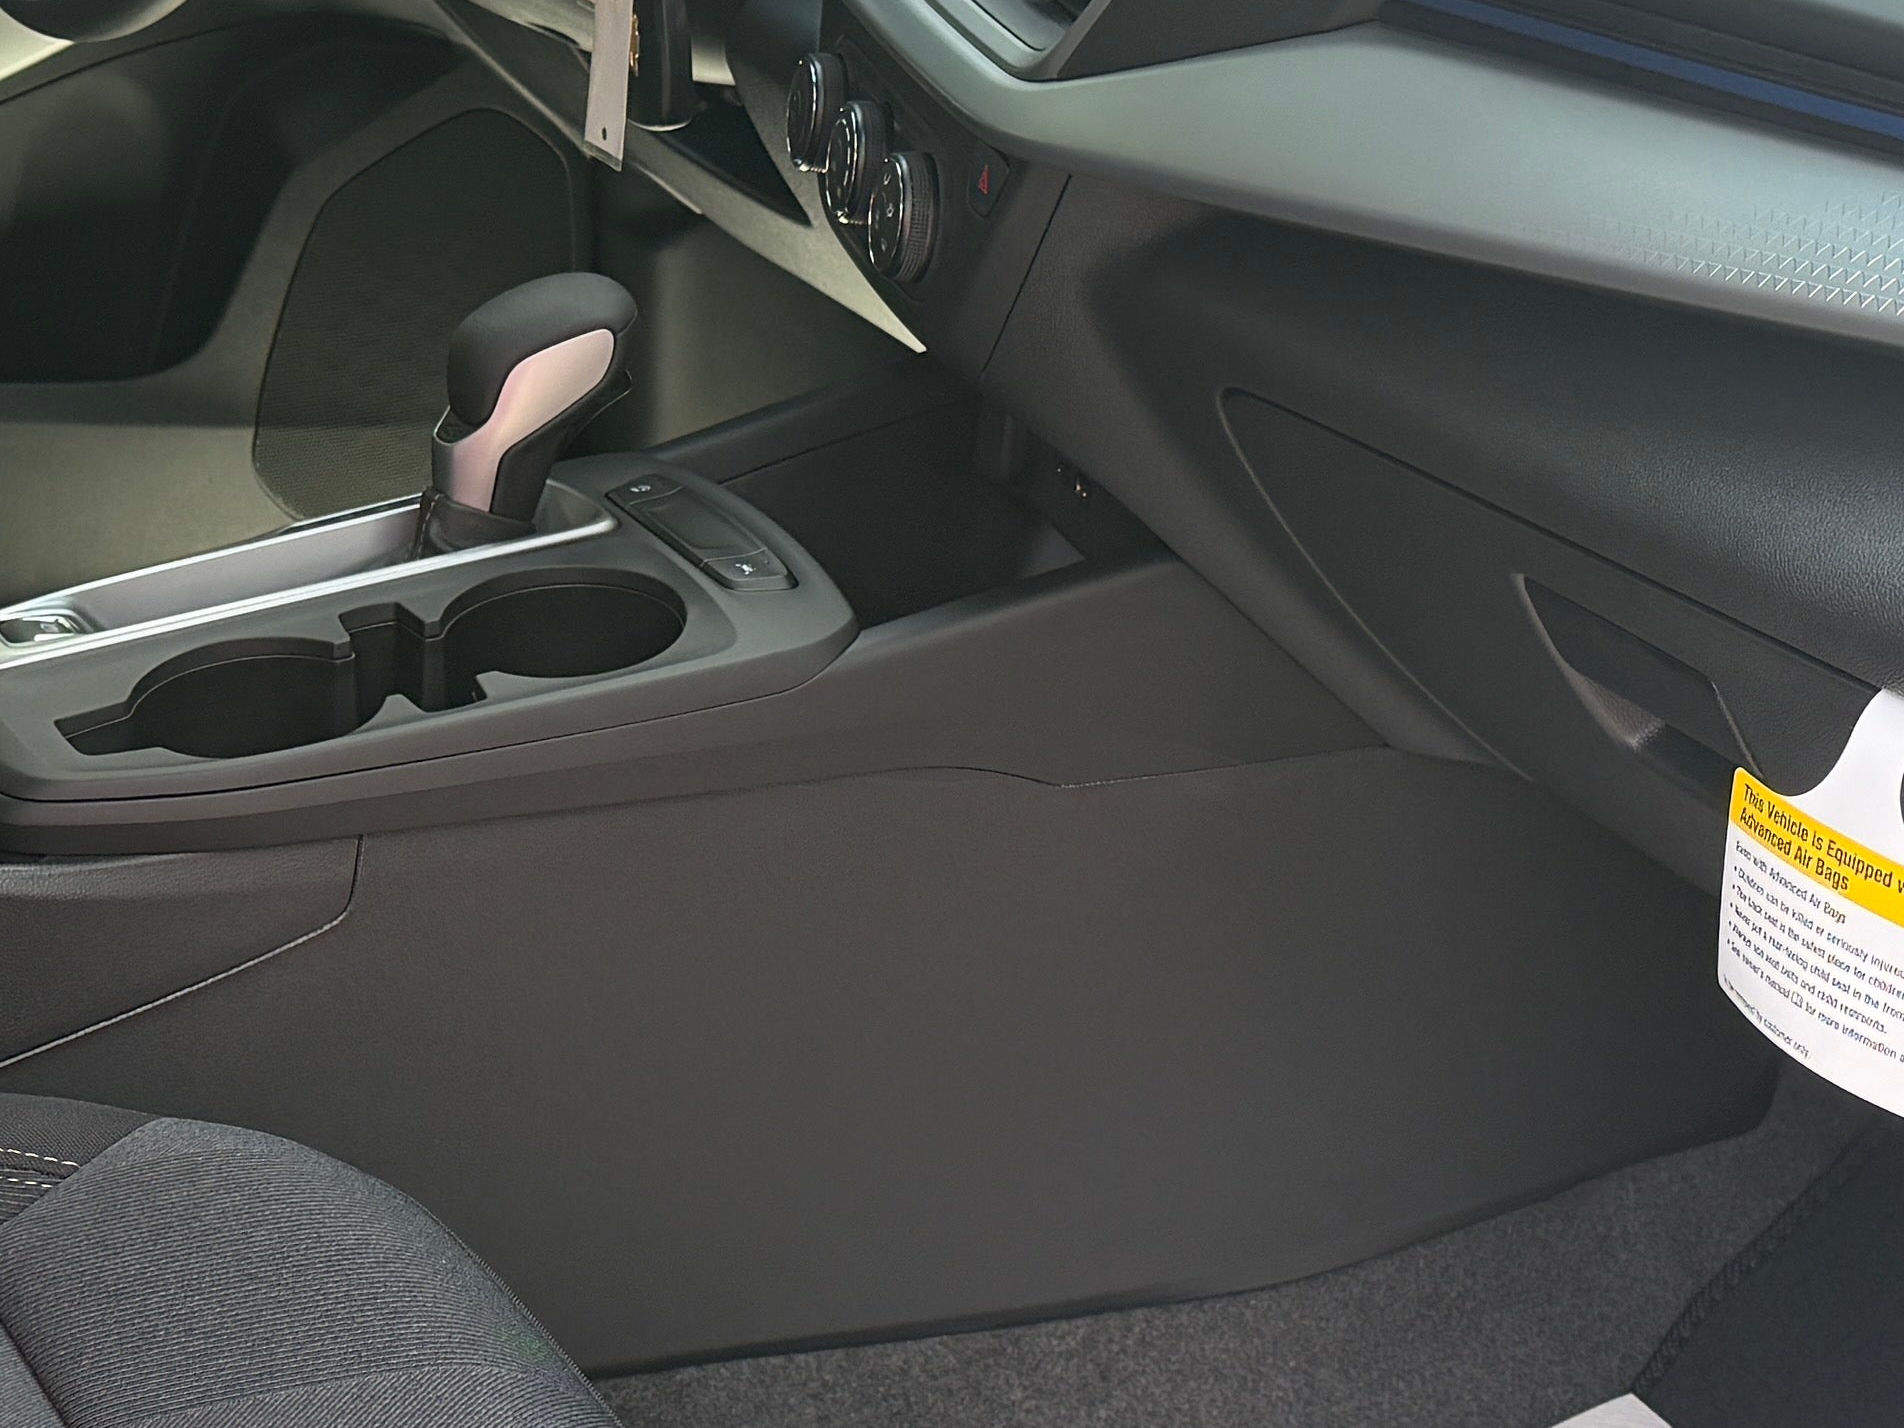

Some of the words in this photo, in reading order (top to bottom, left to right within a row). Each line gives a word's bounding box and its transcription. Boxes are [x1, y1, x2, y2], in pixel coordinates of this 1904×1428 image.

[1739, 806, 1792, 857] Advanced
[1794, 845, 1814, 869] Air
[1815, 857, 1850, 891] Bags
[1744, 783, 1765, 813] This
[1767, 800, 1809, 842] Vehicle
[1826, 838, 1894, 888] Equipped
